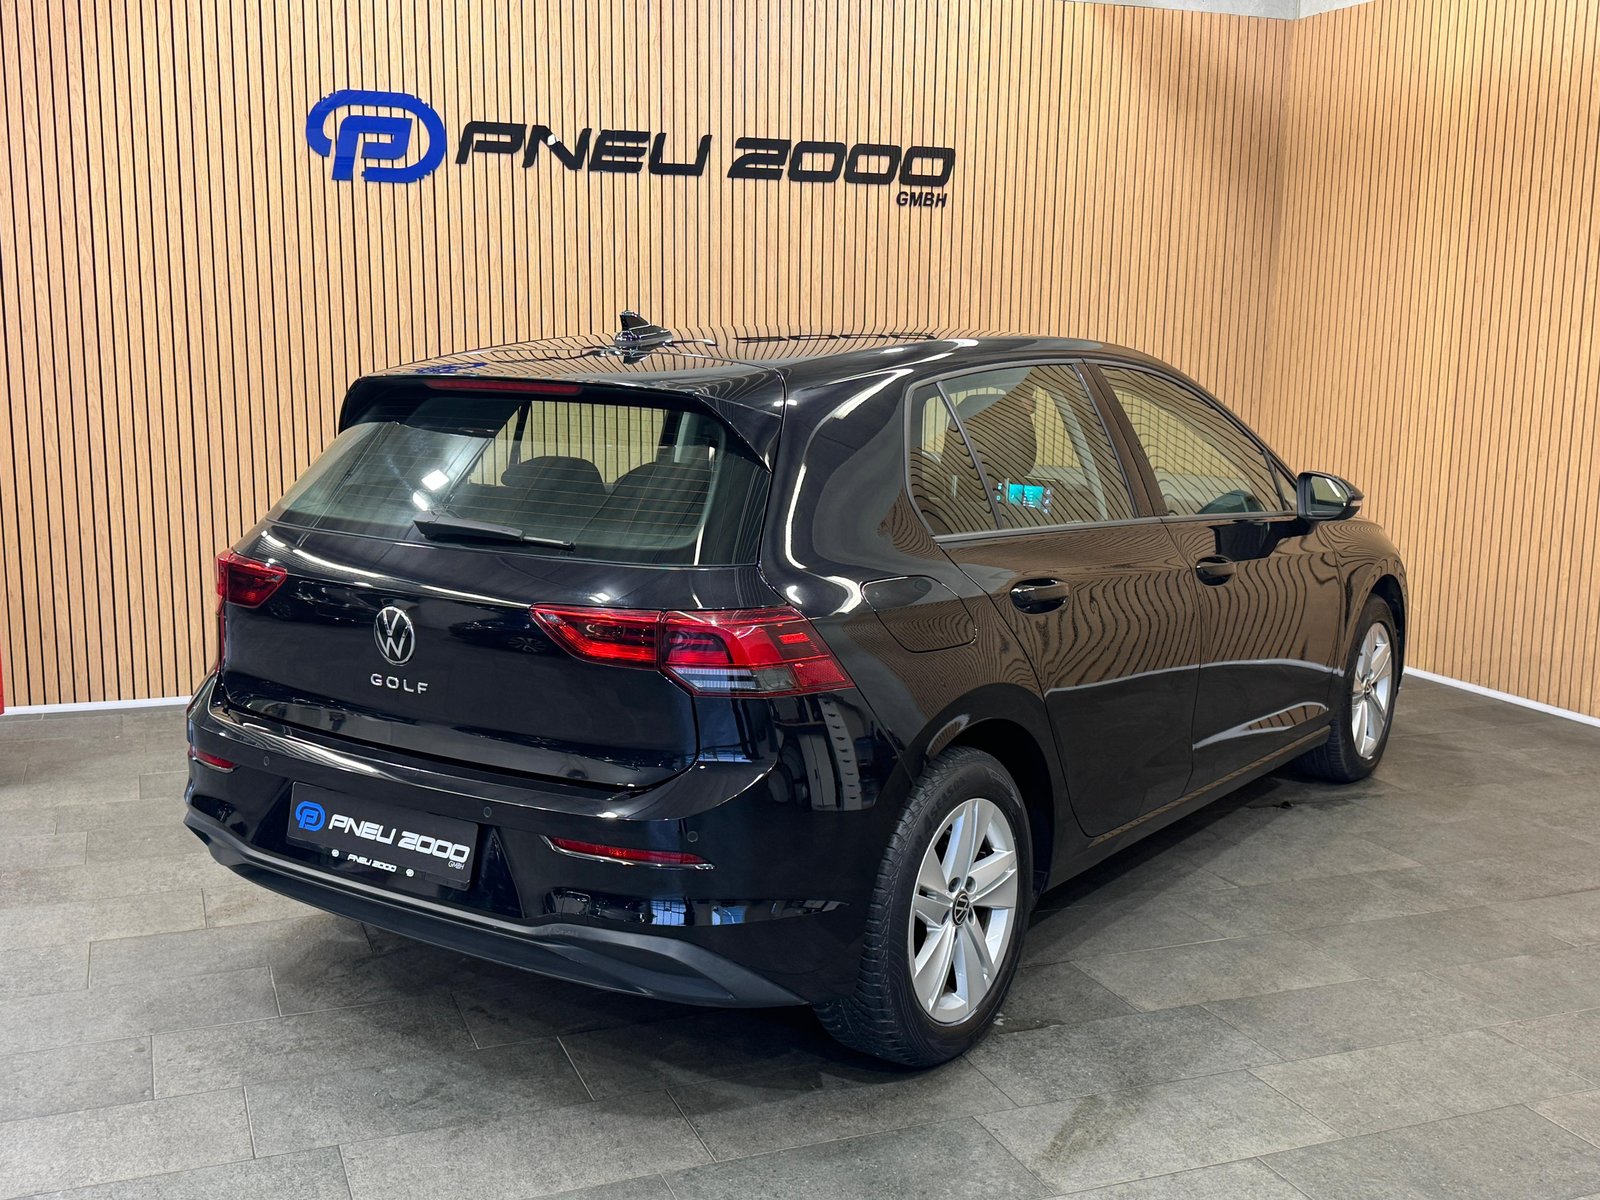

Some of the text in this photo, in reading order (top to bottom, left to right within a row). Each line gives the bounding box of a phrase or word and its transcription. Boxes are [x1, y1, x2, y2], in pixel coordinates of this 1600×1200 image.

[455, 121, 956, 187] PNEU 2000
[896, 191, 948, 208] GMBH
[370, 673, 429, 695] GOLF
[328, 813, 470, 863] PNEU 2000
[347, 853, 397, 873] PNEU 2000
